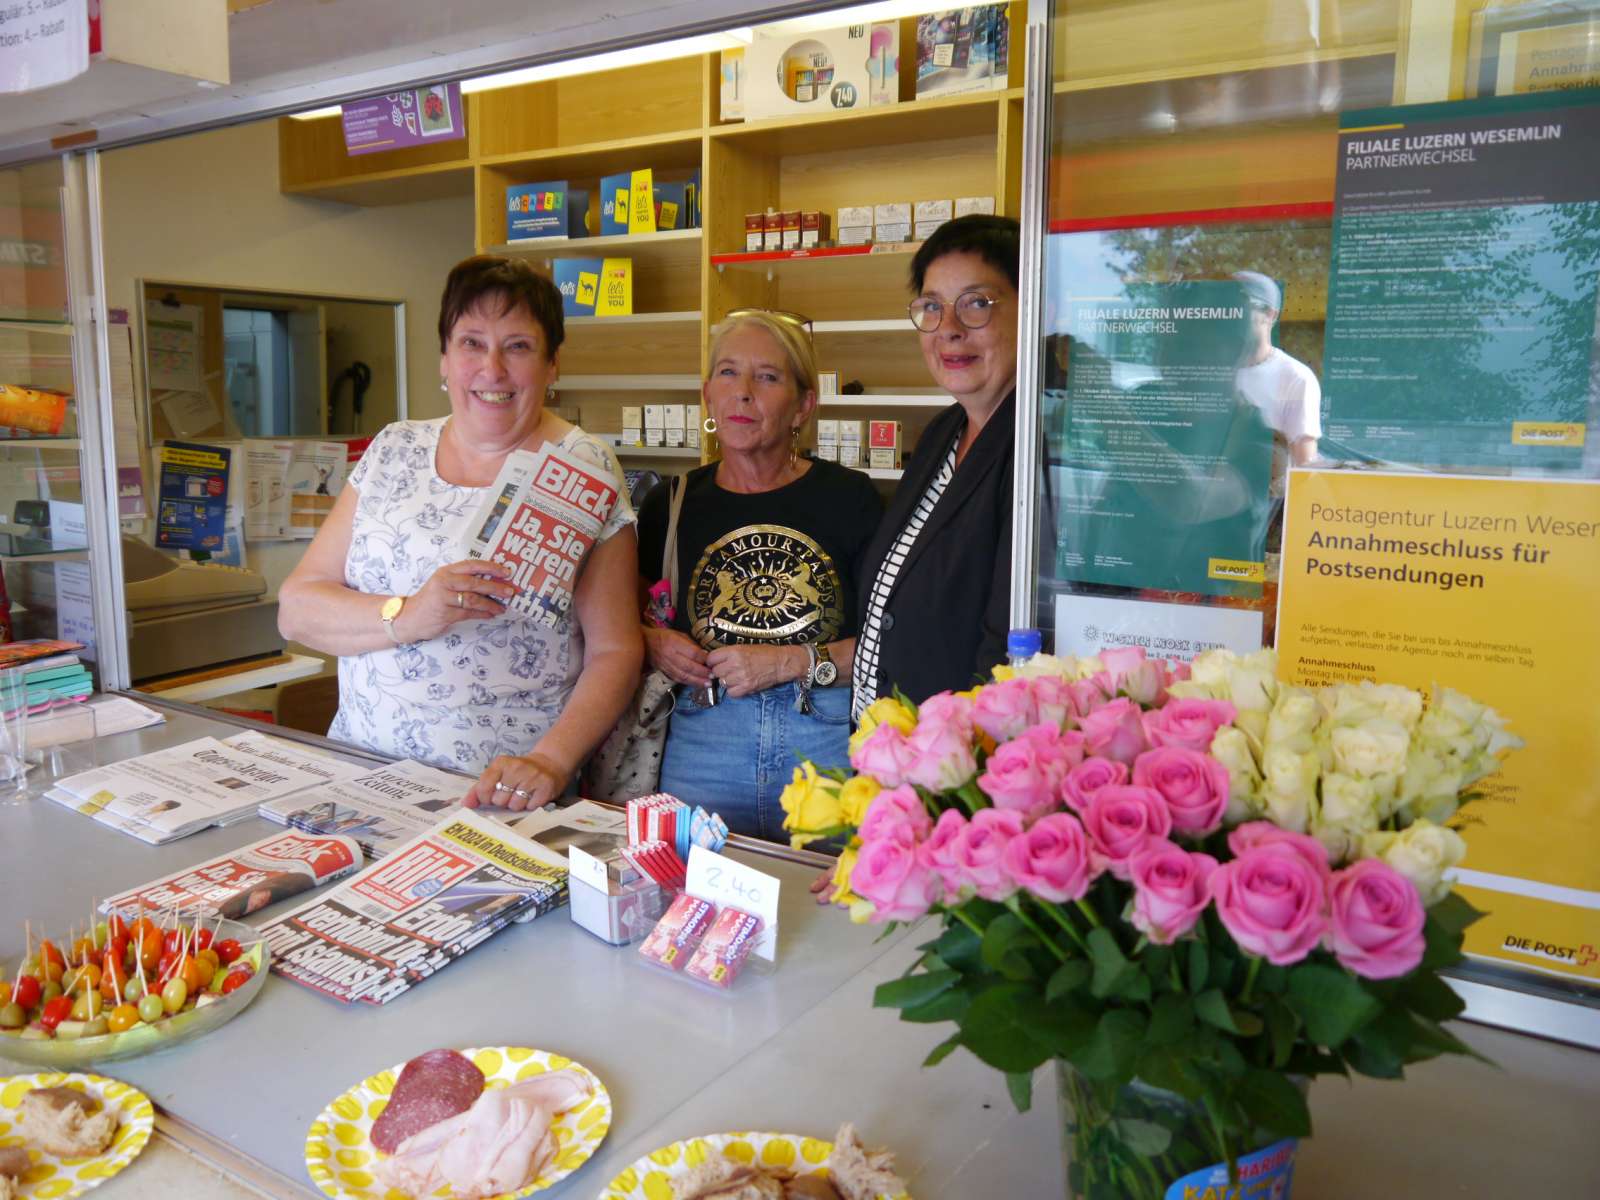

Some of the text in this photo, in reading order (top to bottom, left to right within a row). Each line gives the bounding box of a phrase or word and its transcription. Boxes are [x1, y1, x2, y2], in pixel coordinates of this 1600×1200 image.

[848, 25, 864, 40] NEU
[1346, 124, 1563, 156] FILIALE LUZERN WESEMLIN
[1345, 149, 1477, 171] PARTNERWECHSEL
[1123, 308, 1169, 321] LUZERN
[1172, 306, 1244, 320] WESEMLIN
[1539, 429, 1565, 439] POST
[537, 458, 615, 519] Blick
[1310, 503, 1436, 529] Postagentur
[1443, 511, 1517, 534] Luzern
[511, 508, 544, 545] Ja,
[546, 525, 585, 561] Sie
[720, 534, 793, 561] AMOUR
[1308, 531, 1550, 565] Annahmeschluss für
[503, 532, 576, 582] waren
[1306, 558, 1485, 591] Postsendungen
[1301, 624, 1533, 655] Alle Sendungen, die Sie bei uns bis Annahmeschluss
[1298, 656, 1376, 672] Annahmeschluss
[1344, 640, 1383, 651] verlassen
[1386, 643, 1399, 652] die
[1402, 646, 1438, 657] Agentur
[1441, 649, 1465, 659] noch
[1467, 653, 1481, 661] am
[1484, 654, 1515, 664] selben
[1519, 656, 1534, 669] Tag
[1296, 667, 1330, 681] Montag
[354, 776, 412, 800] Zeitung
[372, 769, 440, 795] Luzerner
[266, 837, 334, 864] Blick
[446, 825, 463, 838] EM
[457, 830, 485, 848] 2024
[480, 838, 494, 851] in
[380, 844, 464, 899] Bild
[483, 866, 503, 879] Am
[705, 866, 762, 904] 2.40
[259, 923, 314, 957] mit
[297, 904, 406, 955] verhöhnt
[1504, 935, 1577, 961] DIE POST
